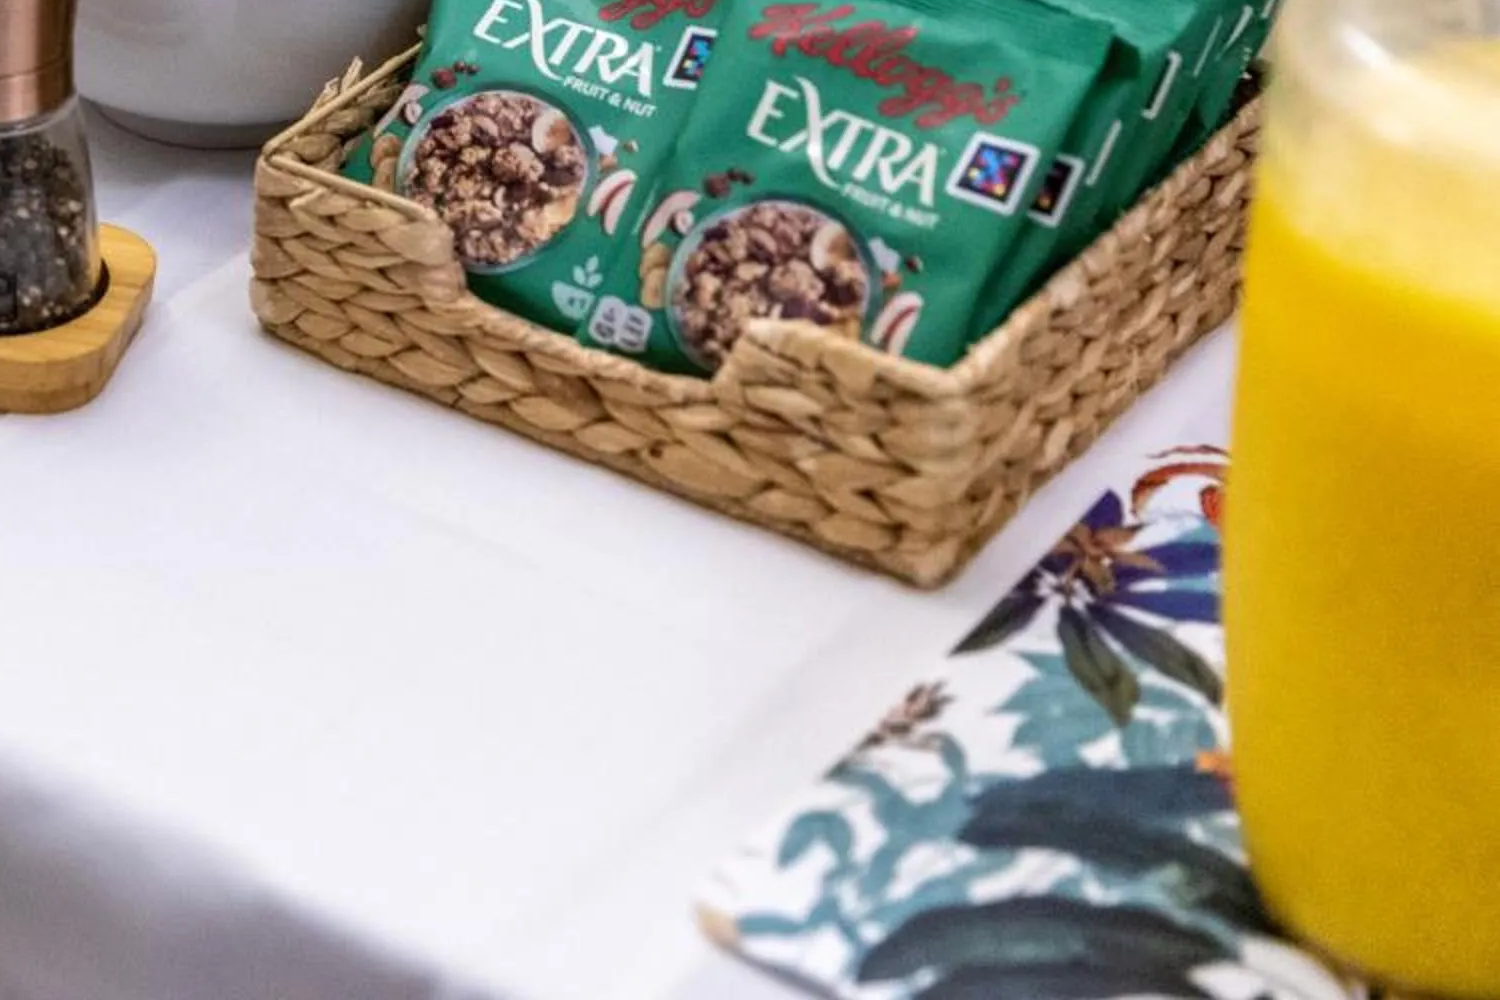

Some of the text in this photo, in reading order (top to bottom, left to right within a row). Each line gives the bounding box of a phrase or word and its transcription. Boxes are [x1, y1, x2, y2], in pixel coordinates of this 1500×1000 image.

[563, 75, 657, 118] FRUIT & NUT
[747, 3, 1022, 130] Kellogg's
[746, 75, 938, 208] EXTRA
